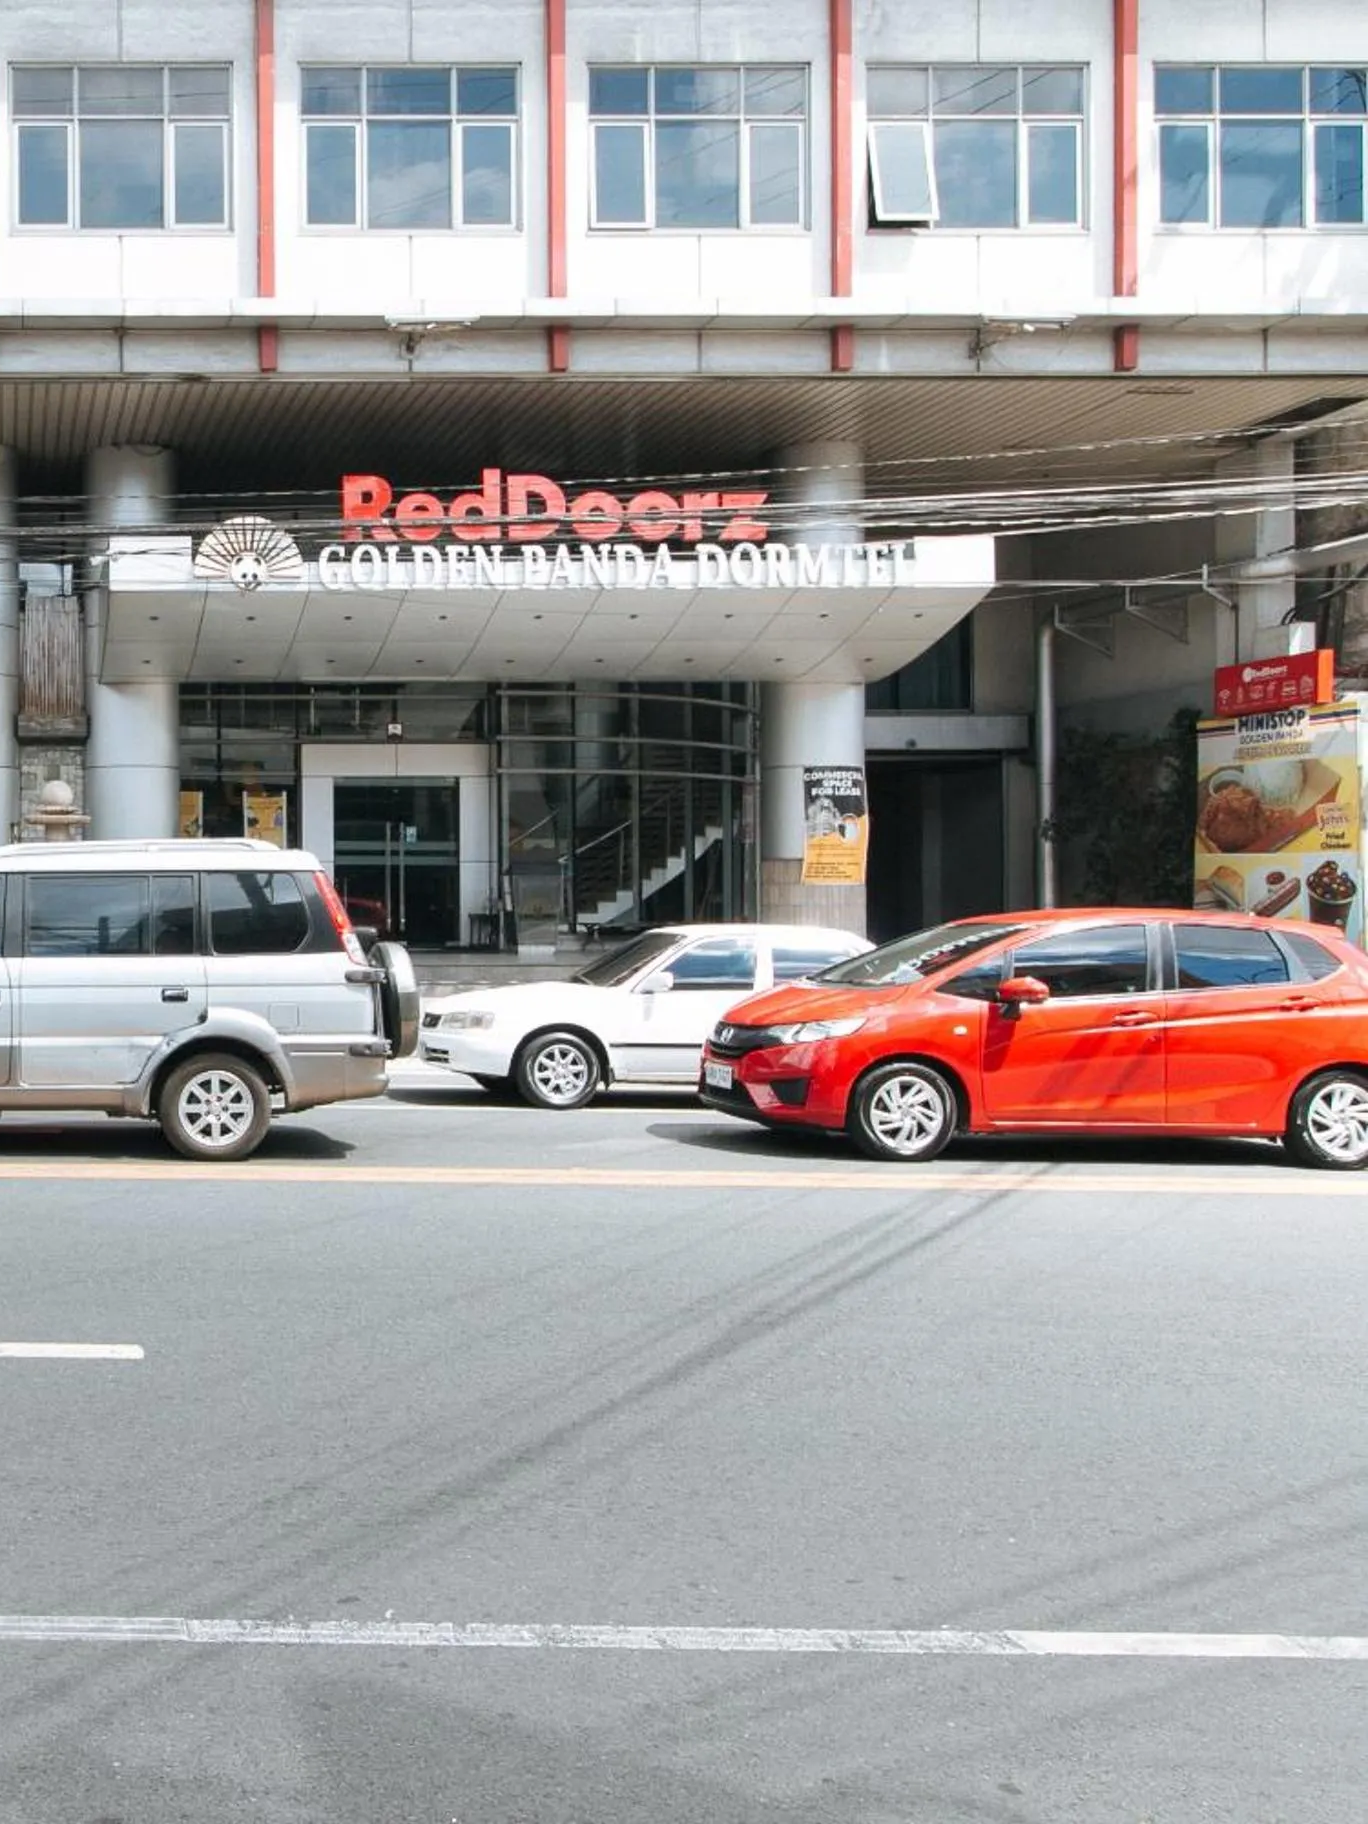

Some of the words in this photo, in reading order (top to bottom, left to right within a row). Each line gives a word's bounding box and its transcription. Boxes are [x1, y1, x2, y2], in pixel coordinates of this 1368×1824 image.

[342, 468, 768, 541] RedDoorz
[318, 543, 503, 590] GOLDEN
[521, 542, 676, 590] PANDA
[1238, 709, 1305, 733] MINISTOP
